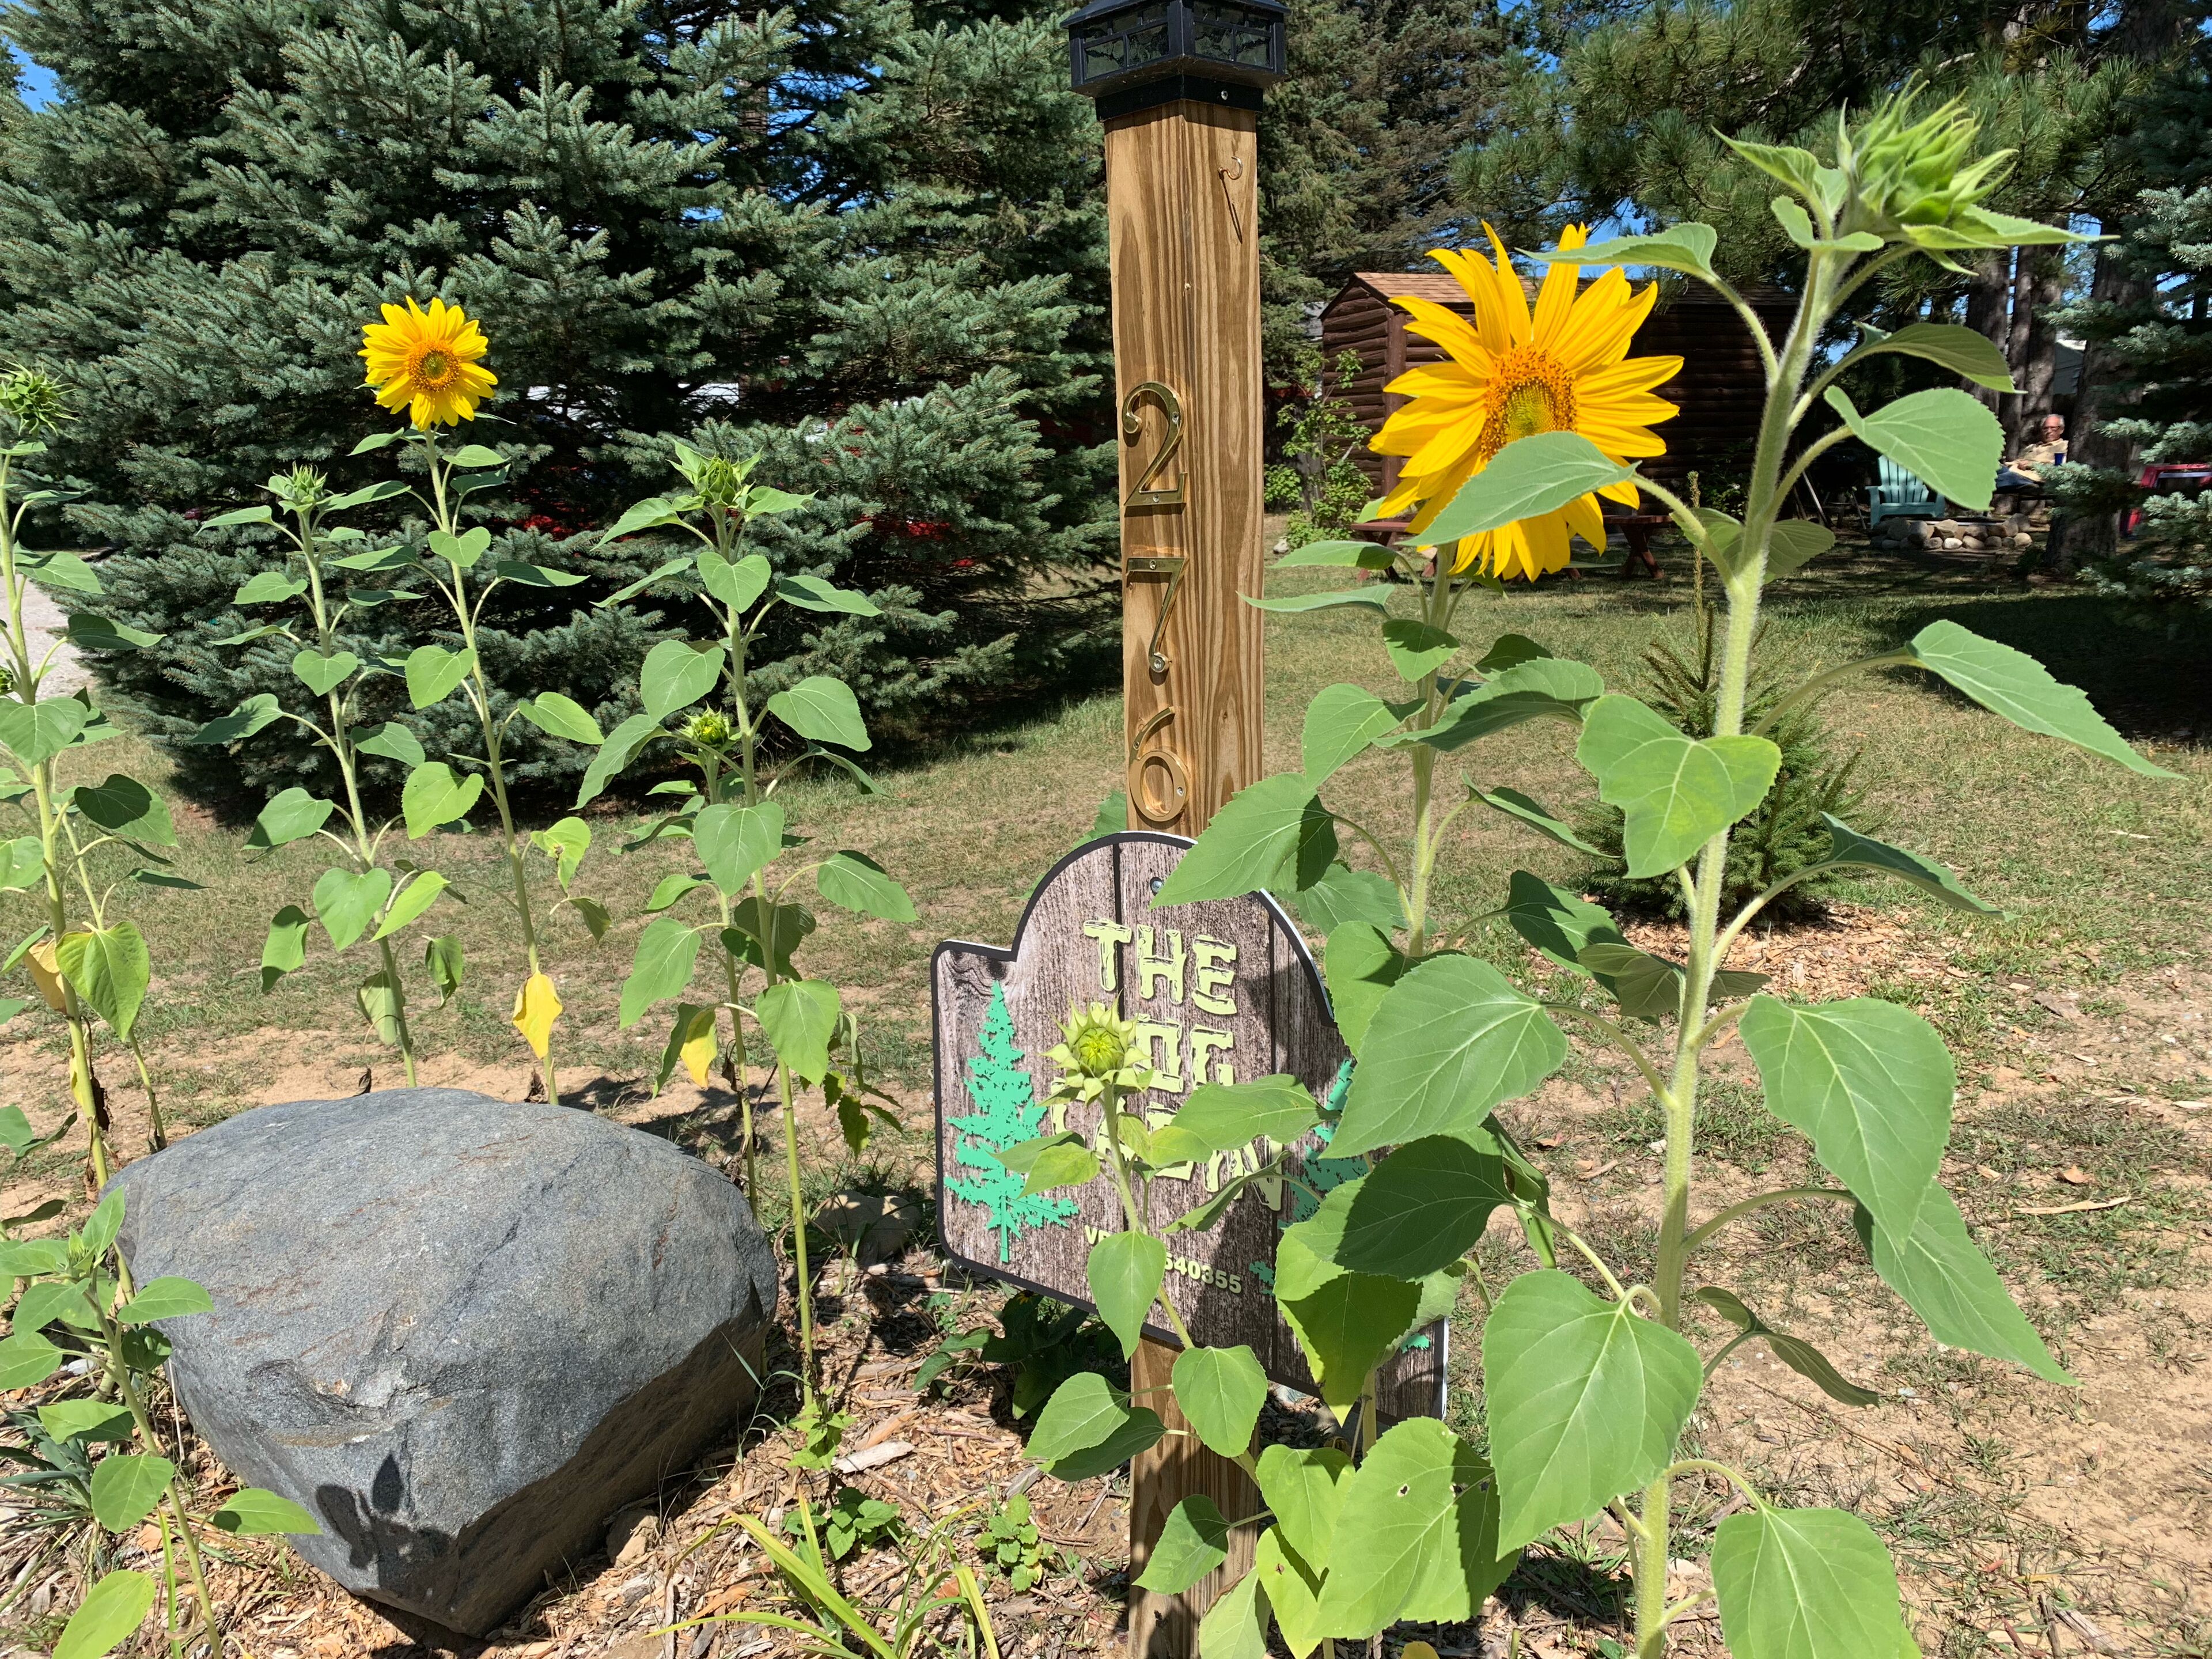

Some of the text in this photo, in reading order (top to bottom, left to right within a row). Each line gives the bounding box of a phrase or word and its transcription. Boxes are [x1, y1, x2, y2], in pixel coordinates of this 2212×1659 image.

[1122, 381, 1189, 822] 276
[1084, 918, 1237, 1014] THE
[1090, 1002, 1234, 1093] OG
